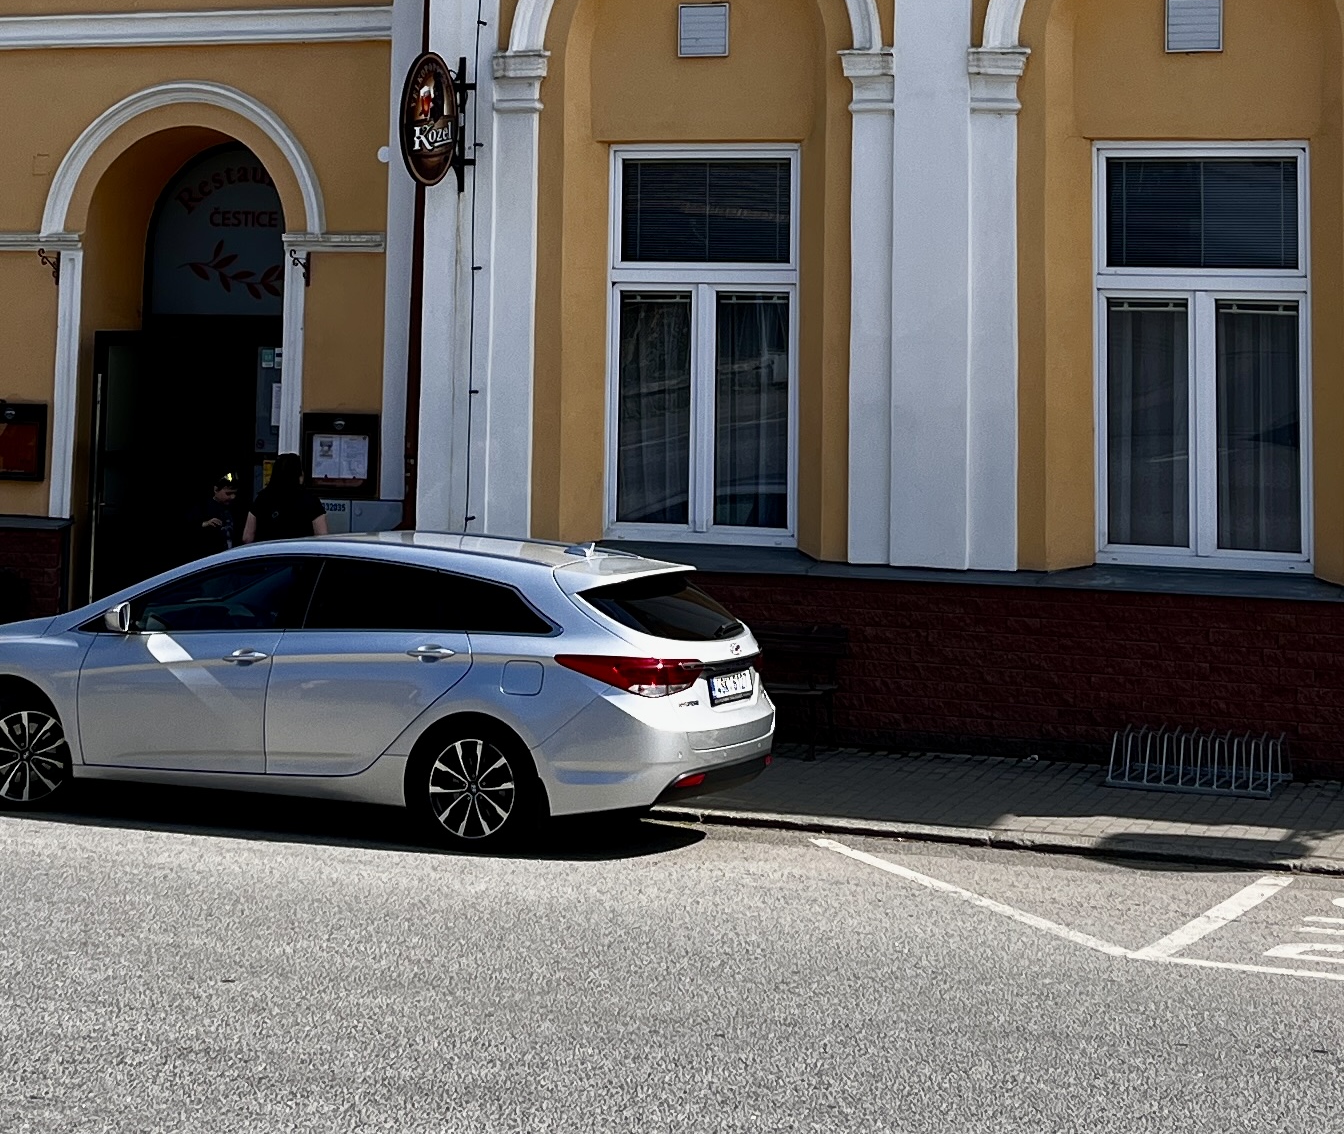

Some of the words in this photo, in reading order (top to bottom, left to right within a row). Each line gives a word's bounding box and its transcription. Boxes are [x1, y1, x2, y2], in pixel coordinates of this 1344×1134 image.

[413, 121, 452, 151] Kozel
[175, 166, 275, 214] Restau
[209, 206, 279, 227] ČESTICE
